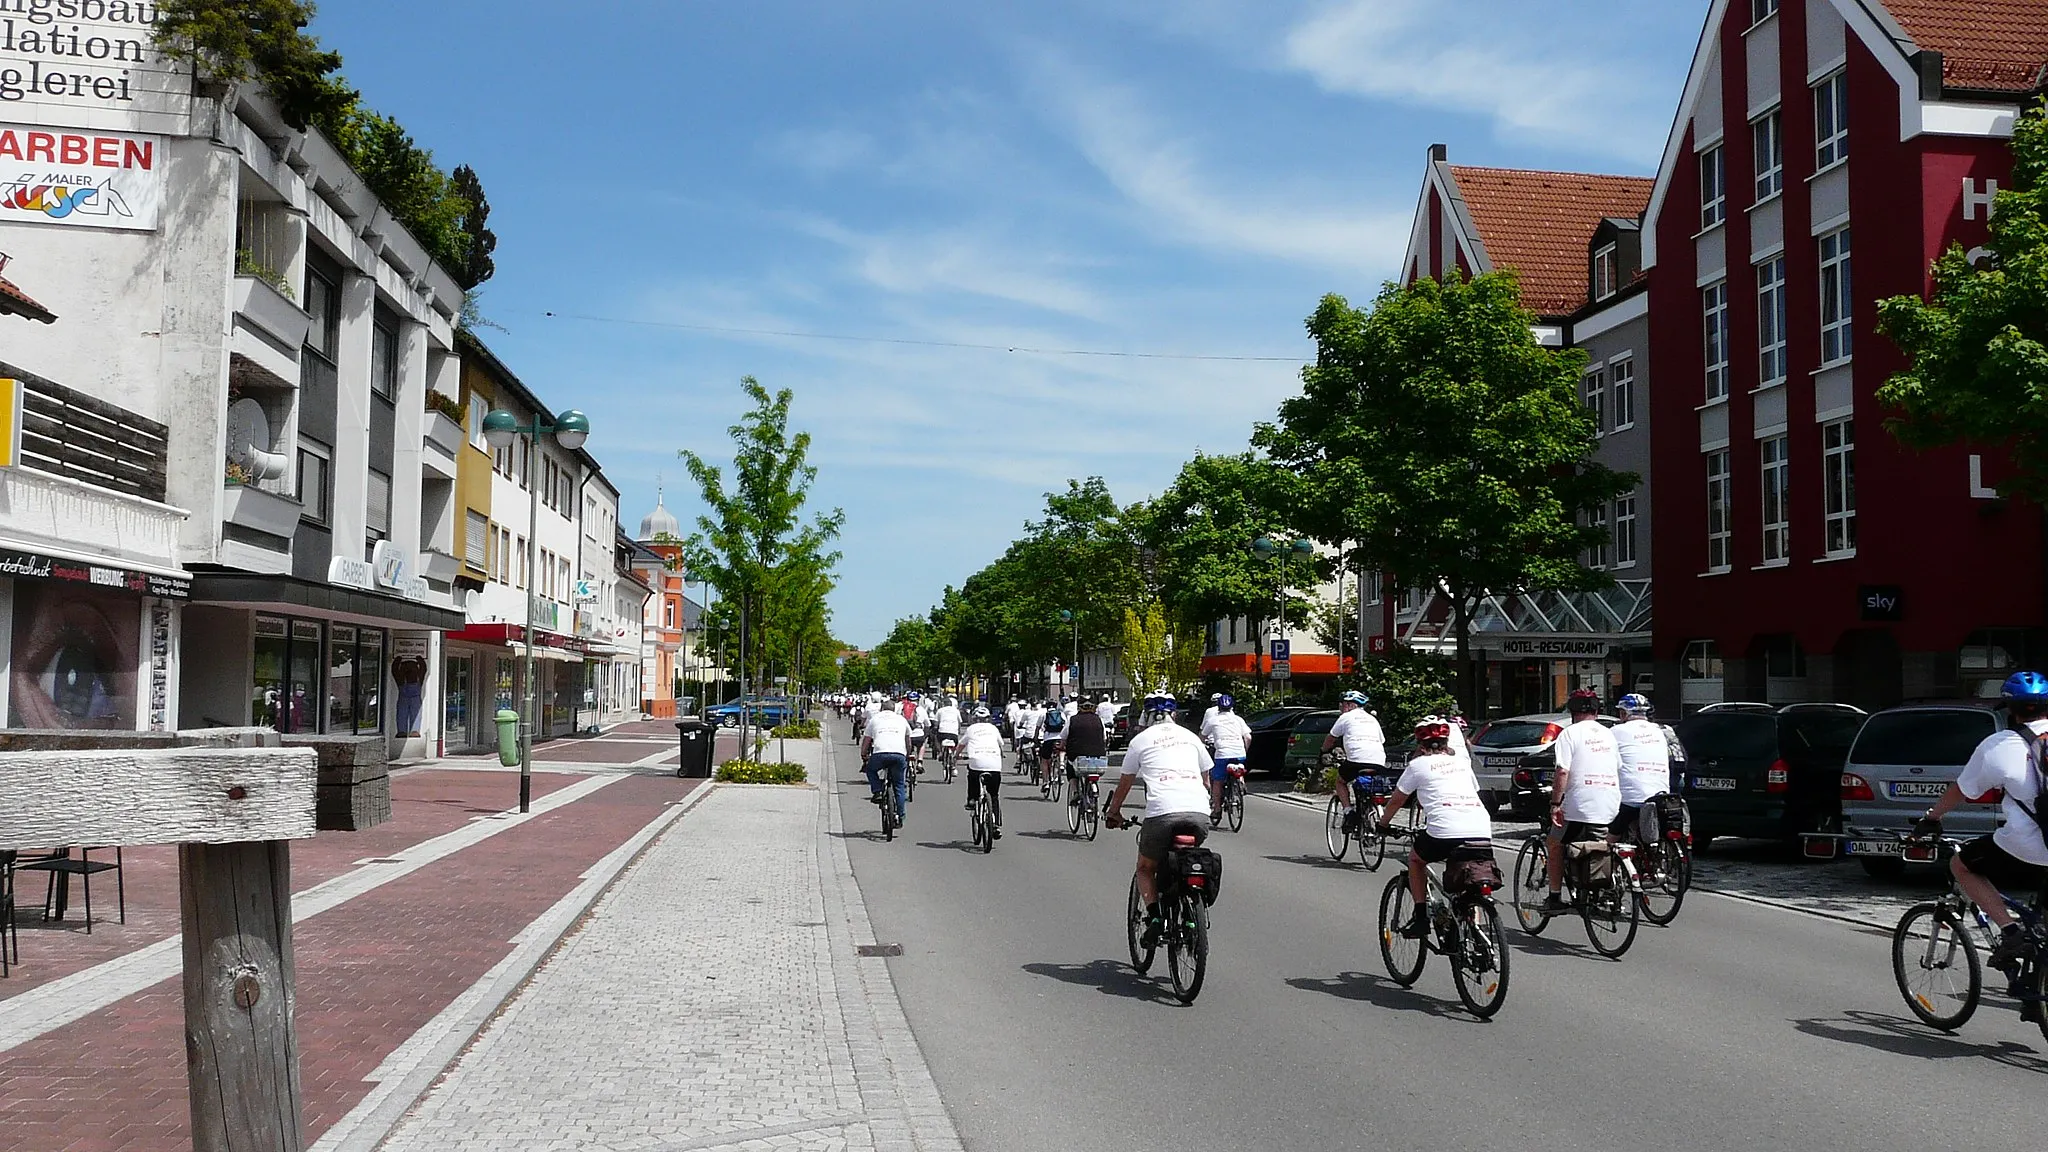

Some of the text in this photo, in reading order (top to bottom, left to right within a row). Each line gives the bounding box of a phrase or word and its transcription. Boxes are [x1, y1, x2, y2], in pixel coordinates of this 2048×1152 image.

[1, 19, 145, 63] lation
[0, 61, 133, 101] glerei
[0, 129, 153, 171] ARBEN
[42, 173, 92, 187] MALER
[90, 566, 124, 588] WERBUNG
[1867, 593, 1896, 612] sky
[1275, 642, 1286, 659] P
